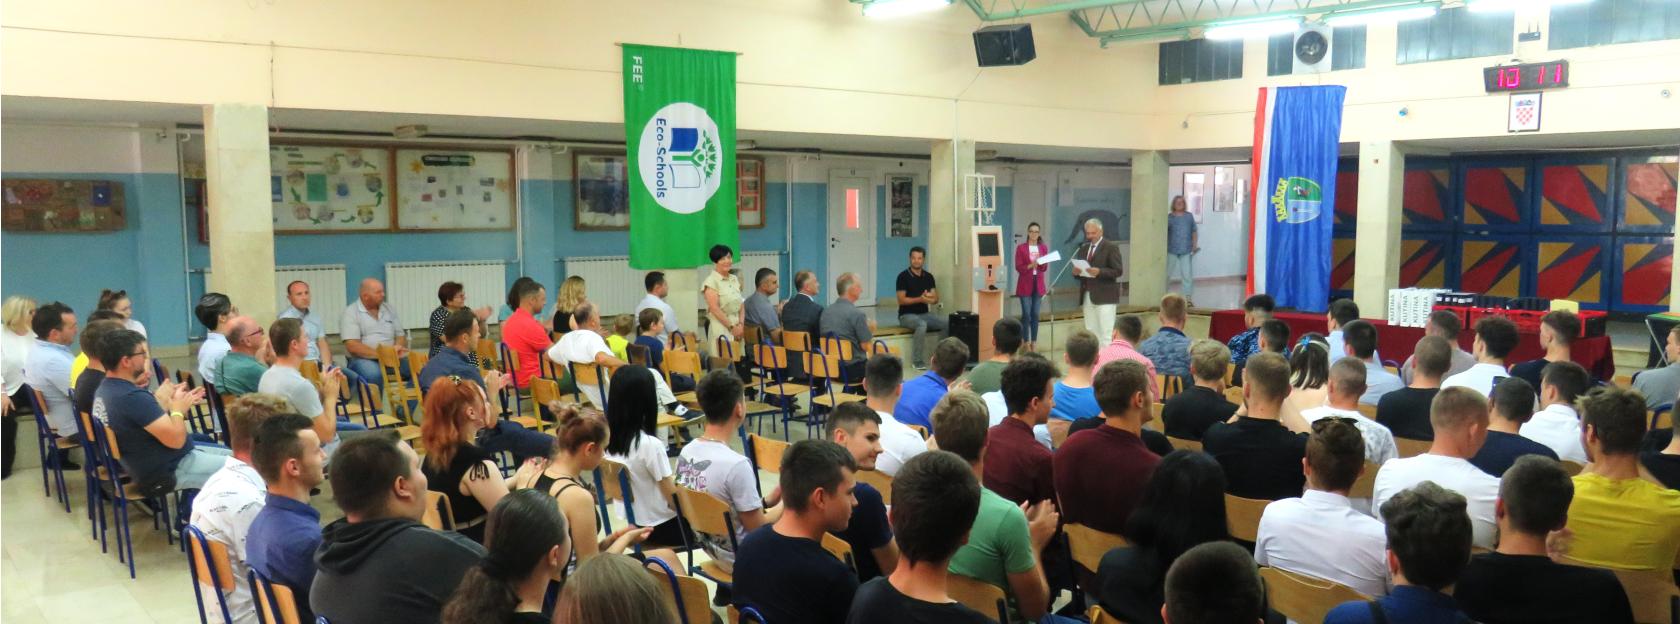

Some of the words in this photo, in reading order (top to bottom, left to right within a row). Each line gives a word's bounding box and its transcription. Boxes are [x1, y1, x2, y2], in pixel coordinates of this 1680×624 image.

[632, 56, 643, 83] FEE
[1497, 68, 1520, 88] 10
[656, 118, 667, 198] Eco-Schools
